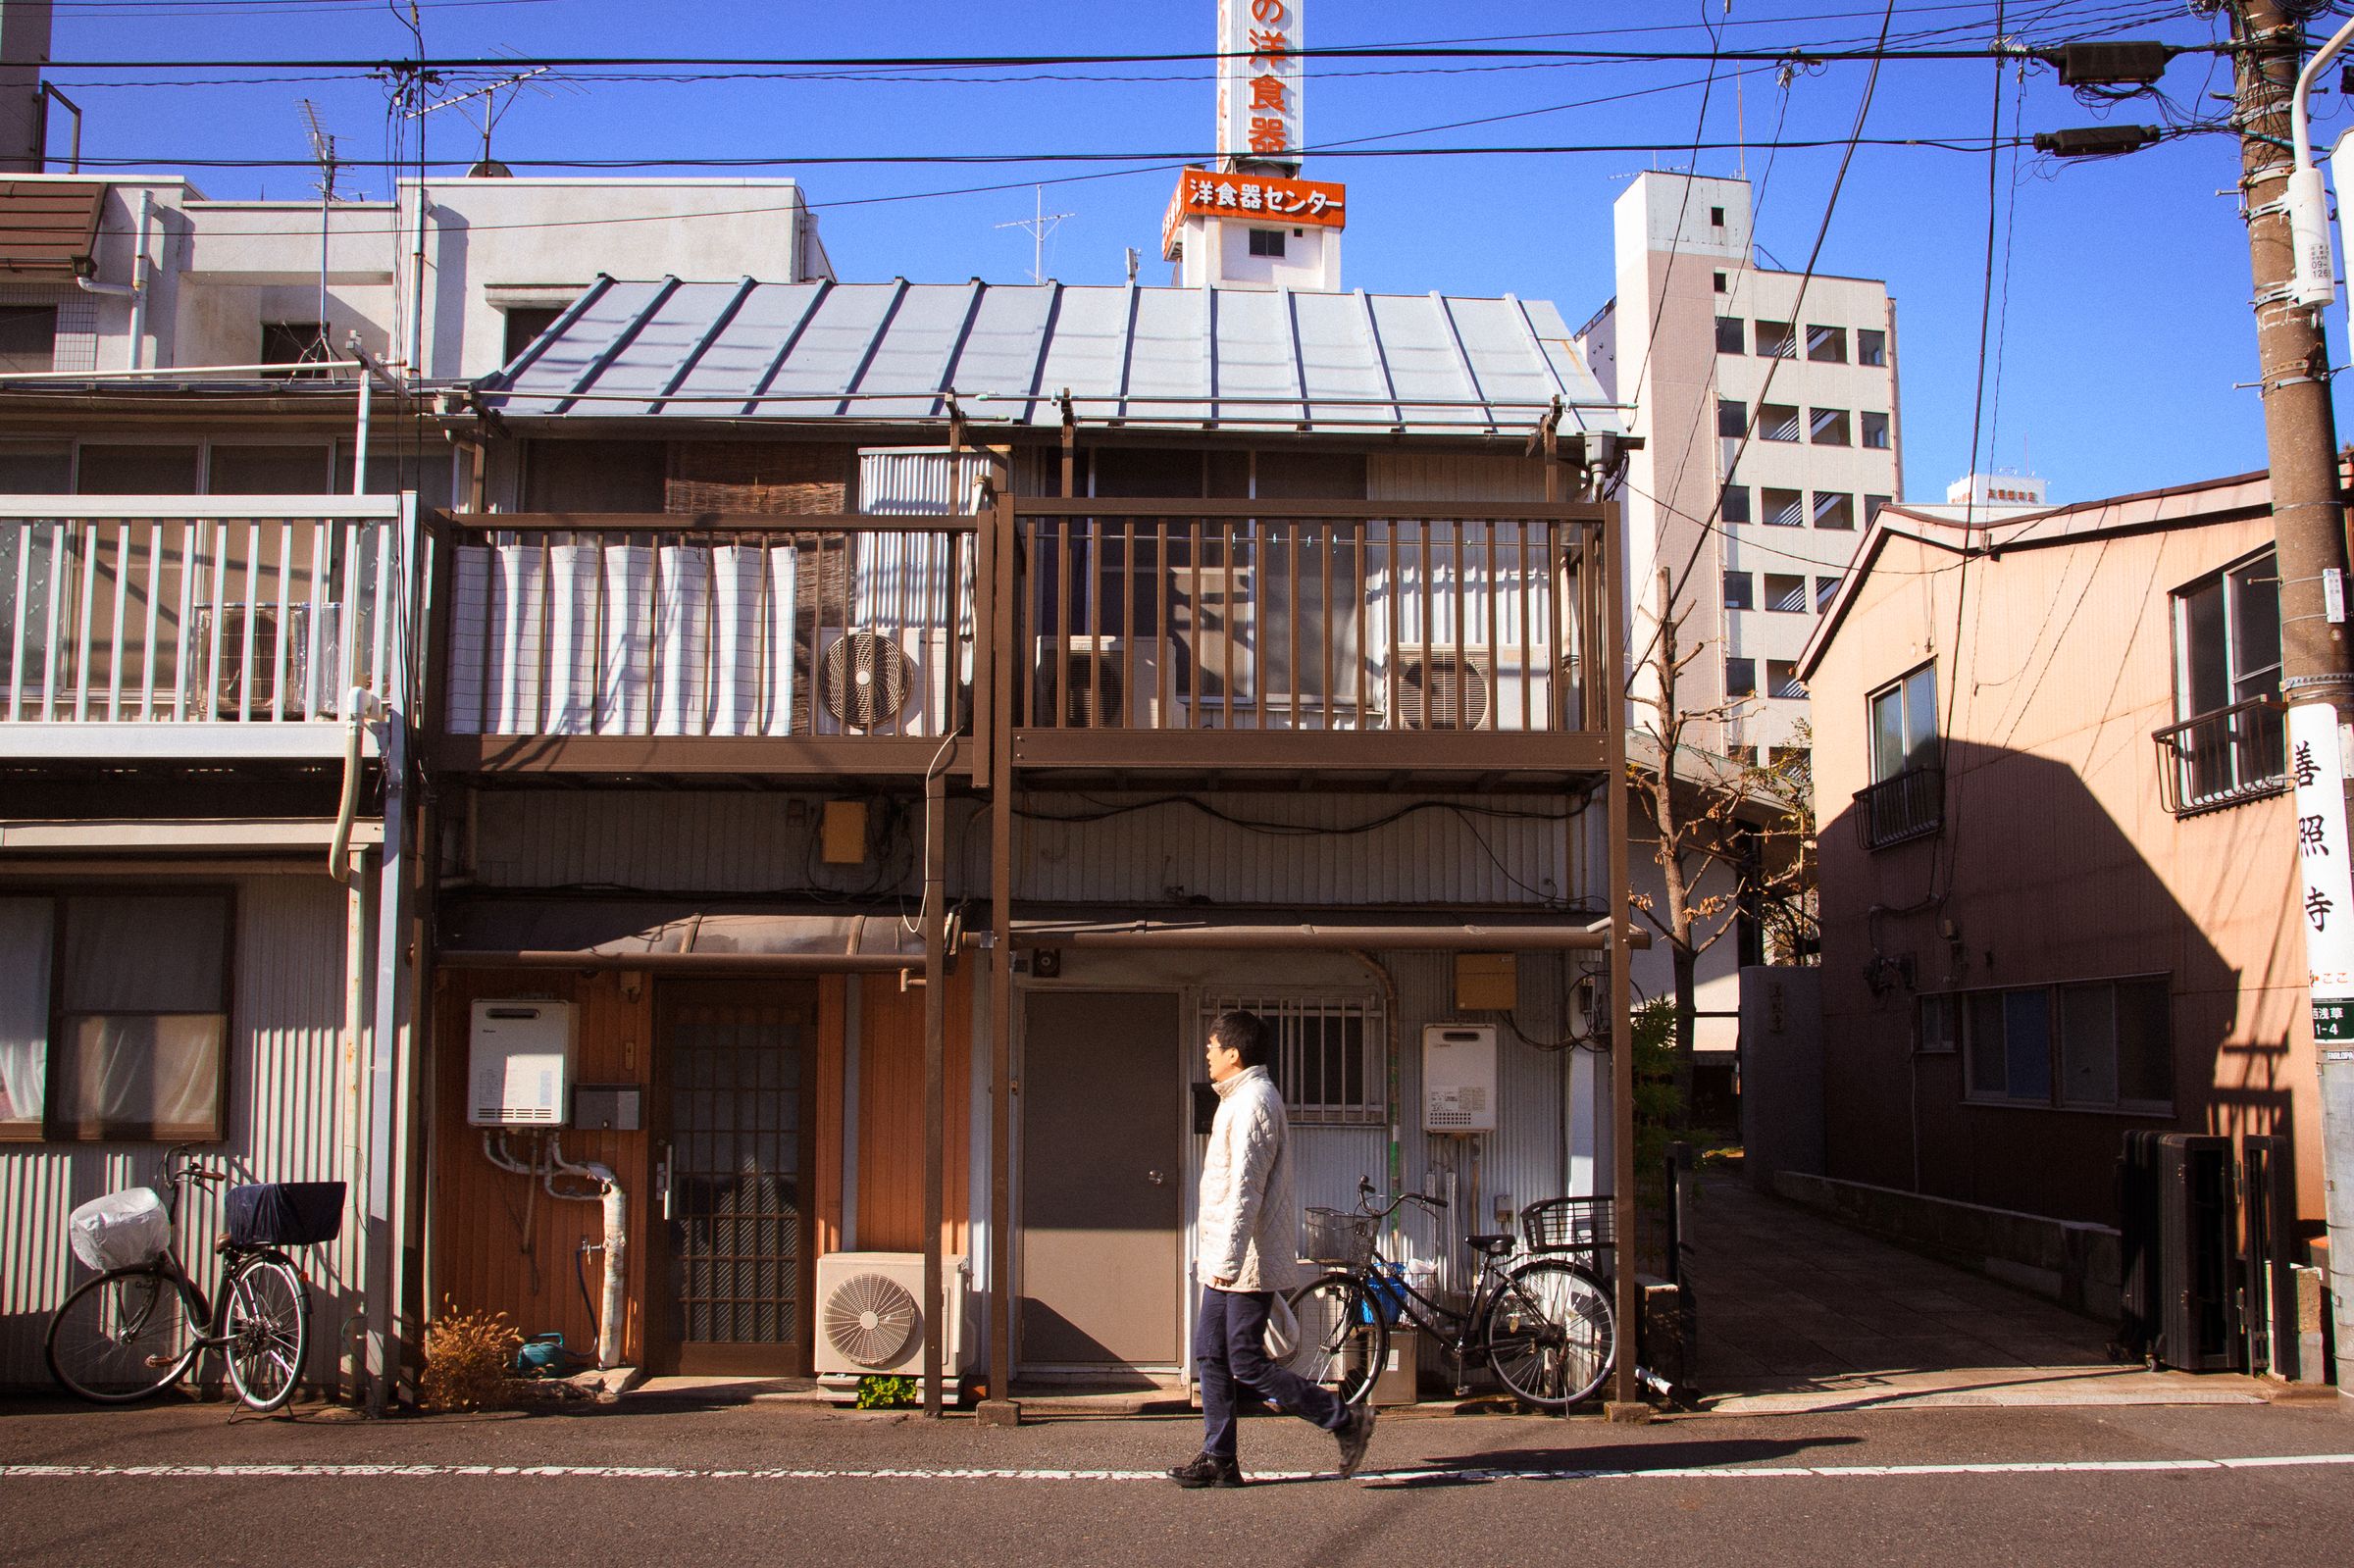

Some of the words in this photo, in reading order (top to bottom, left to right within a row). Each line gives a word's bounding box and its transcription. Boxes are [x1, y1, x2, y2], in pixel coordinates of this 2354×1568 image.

[1248, 0, 1287, 154] の洋食器
[1189, 177, 1343, 215] 洋食器センター
[2294, 739, 2334, 934] 善照寺
[2316, 1023, 2339, 1036] 1-4
